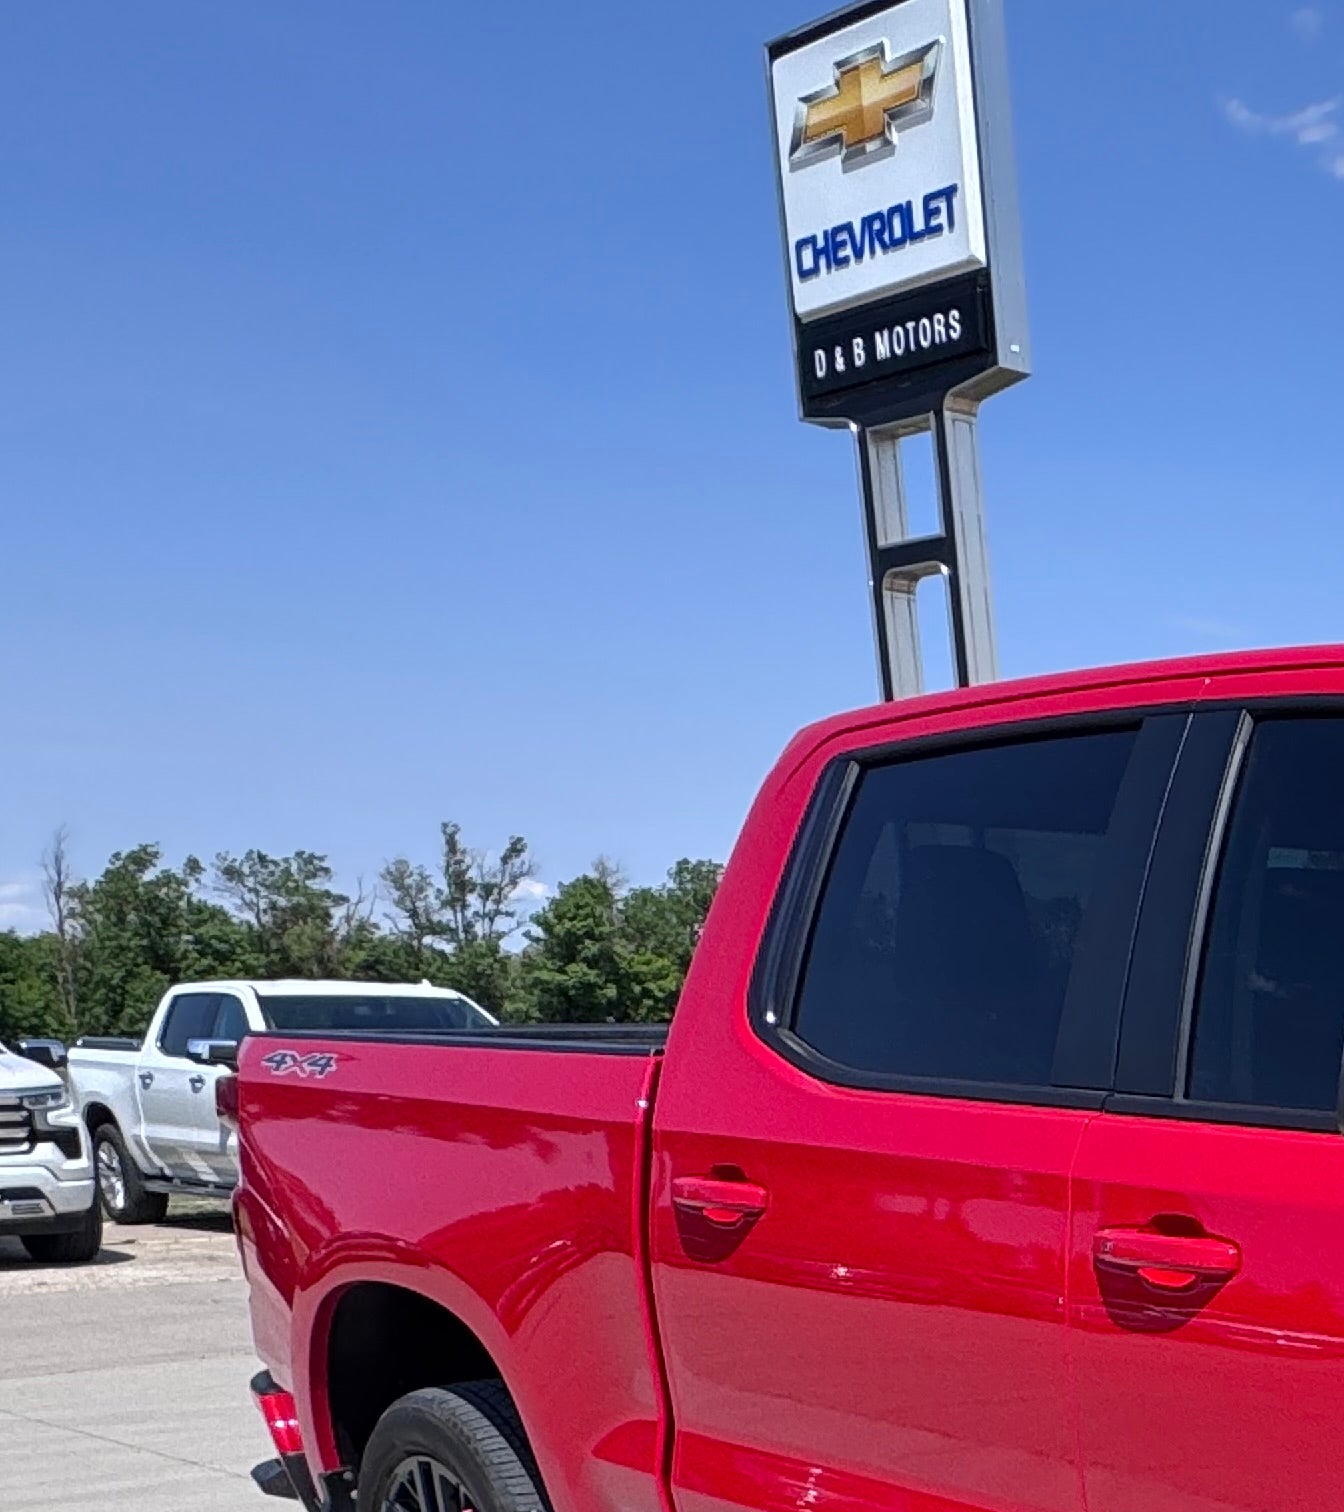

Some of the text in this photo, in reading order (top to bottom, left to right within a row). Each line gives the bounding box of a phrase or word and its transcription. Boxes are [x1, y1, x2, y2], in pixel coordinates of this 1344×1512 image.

[794, 183, 958, 279] CHEVROLET
[814, 308, 962, 379] D & B MOTORS
